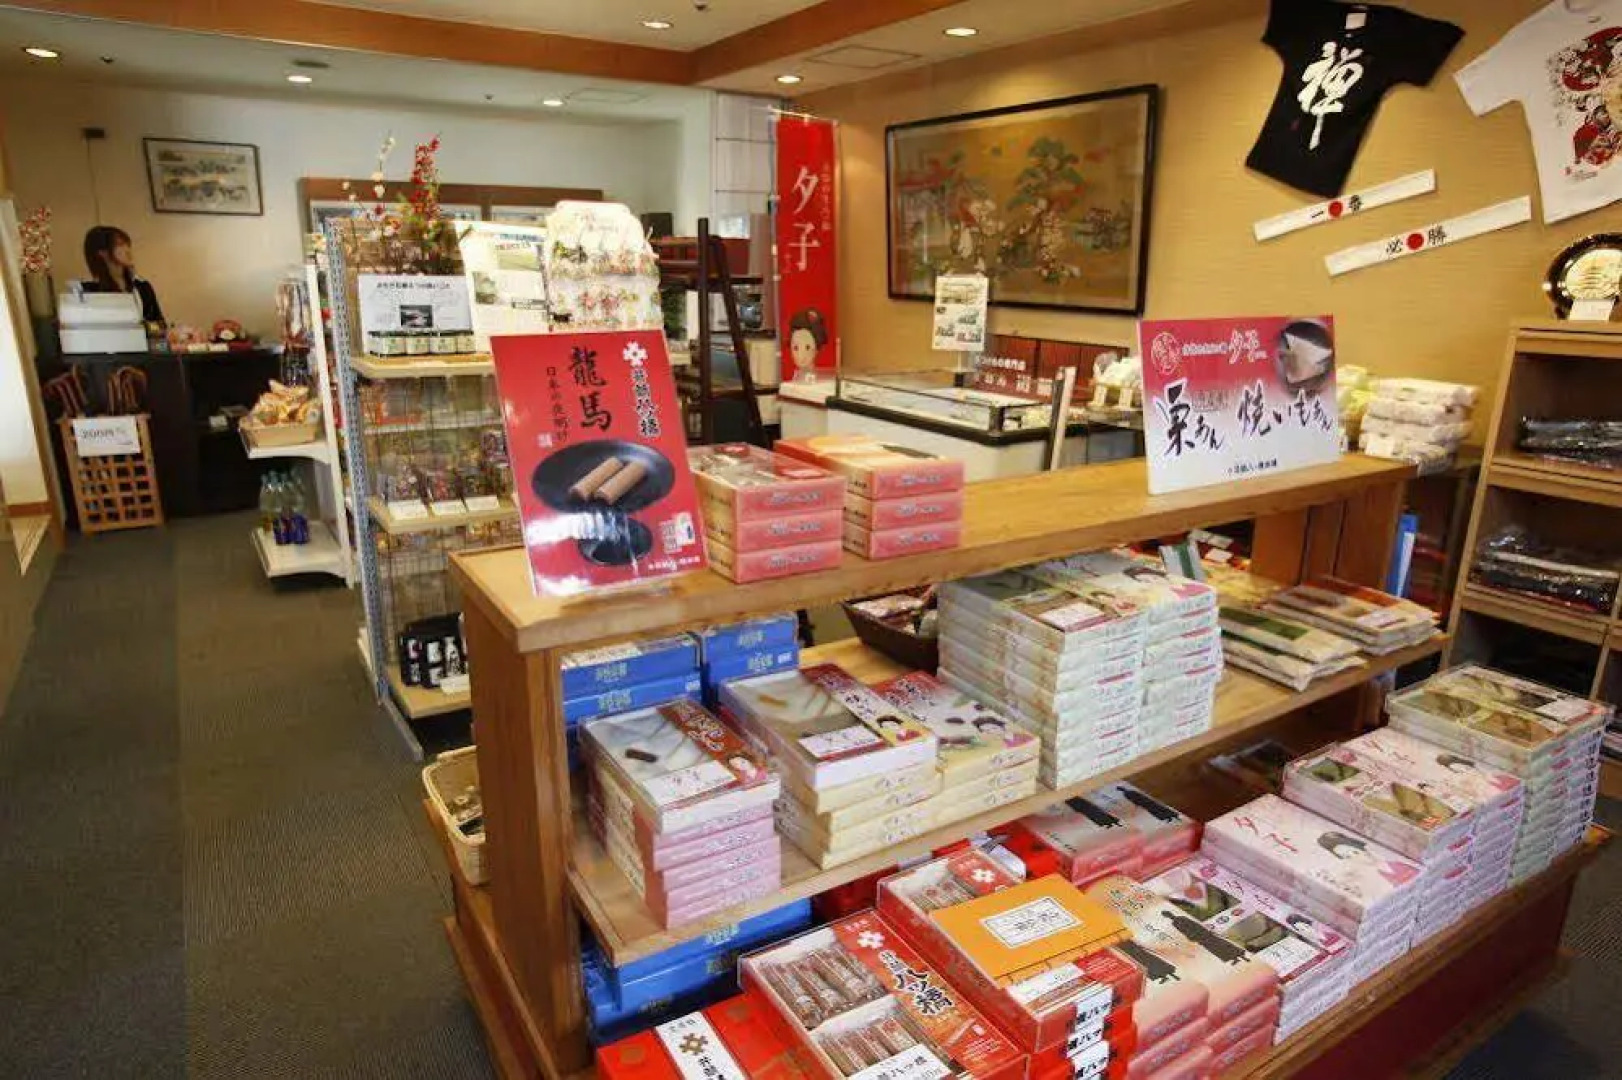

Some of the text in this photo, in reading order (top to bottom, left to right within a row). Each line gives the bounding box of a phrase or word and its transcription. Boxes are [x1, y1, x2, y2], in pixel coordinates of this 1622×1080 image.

[1297, 41, 1363, 150] 禅
[788, 165, 820, 271] 夕子
[568, 346, 612, 431] 龍馬
